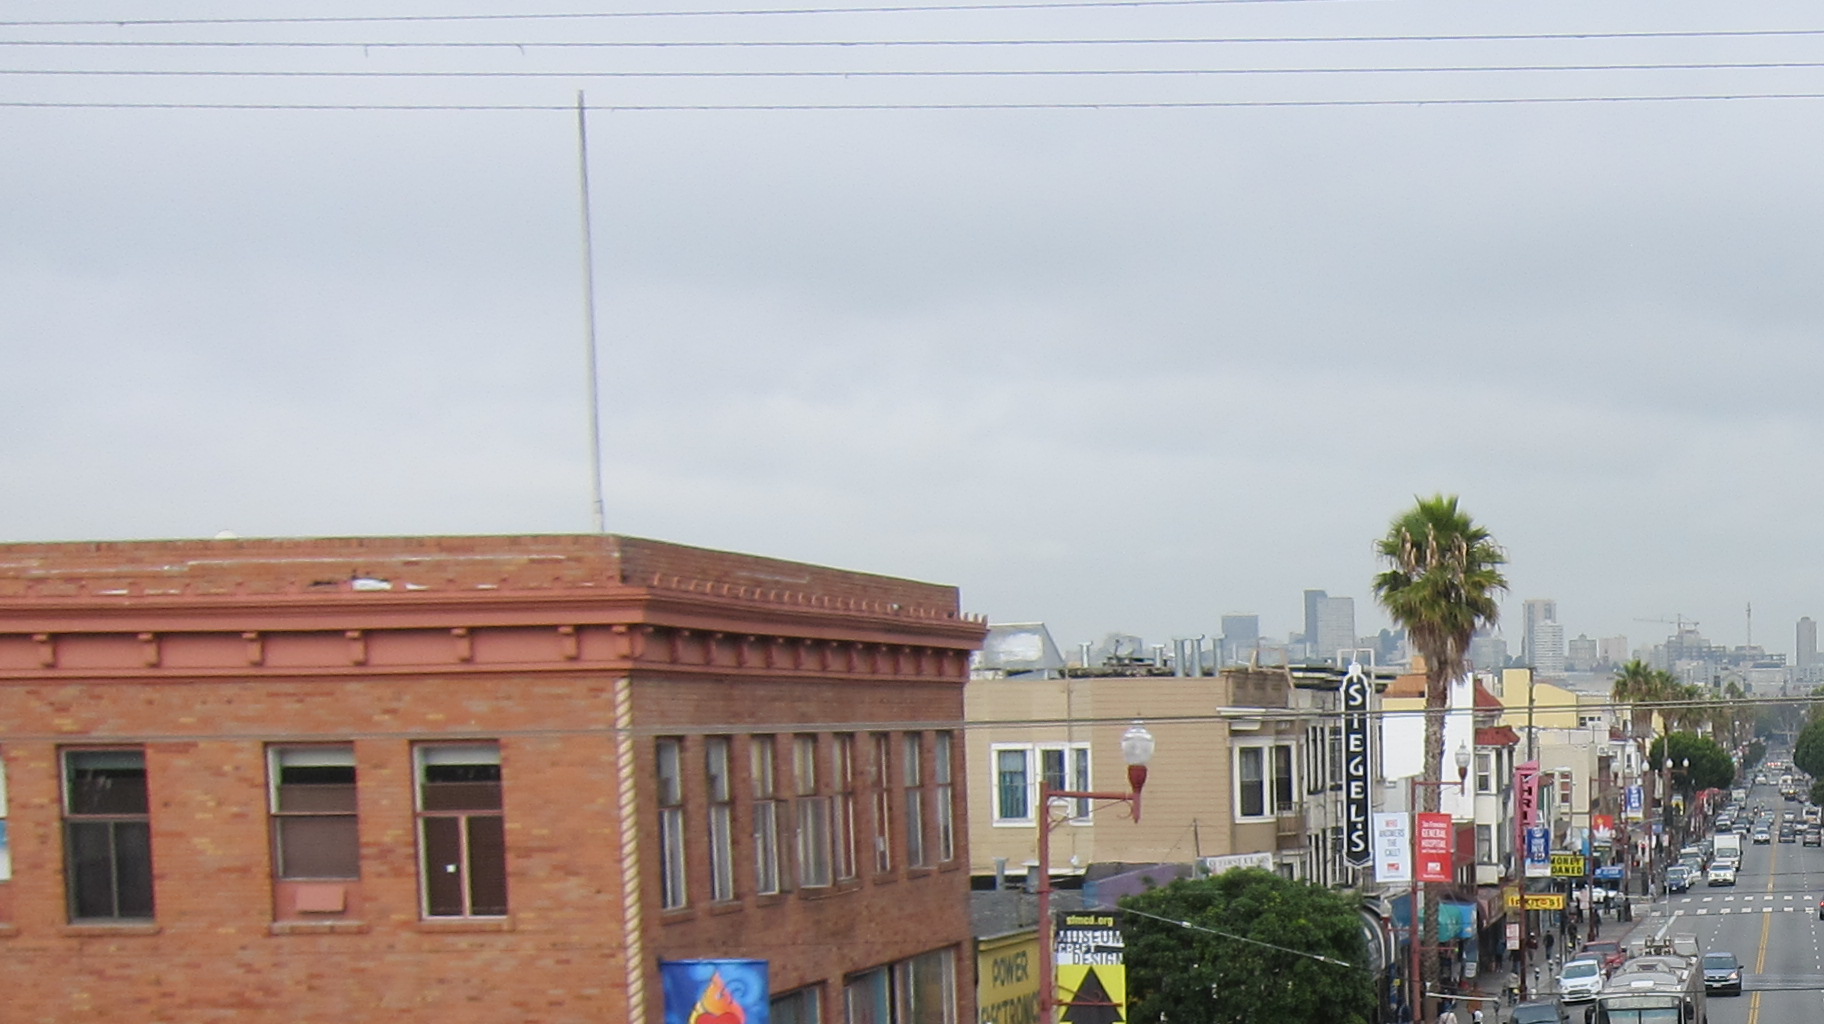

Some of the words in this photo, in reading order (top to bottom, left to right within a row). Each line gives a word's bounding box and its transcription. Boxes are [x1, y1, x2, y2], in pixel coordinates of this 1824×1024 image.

[1348, 683, 1366, 852] SIEGEL'S
[1551, 866, 1583, 875] OANED
[1066, 915, 1114, 927] sfmcd.org
[1057, 929, 1123, 944] MUSEUM
[1072, 953, 1123, 965] DESIGN
[992, 949, 1028, 988] POWER
